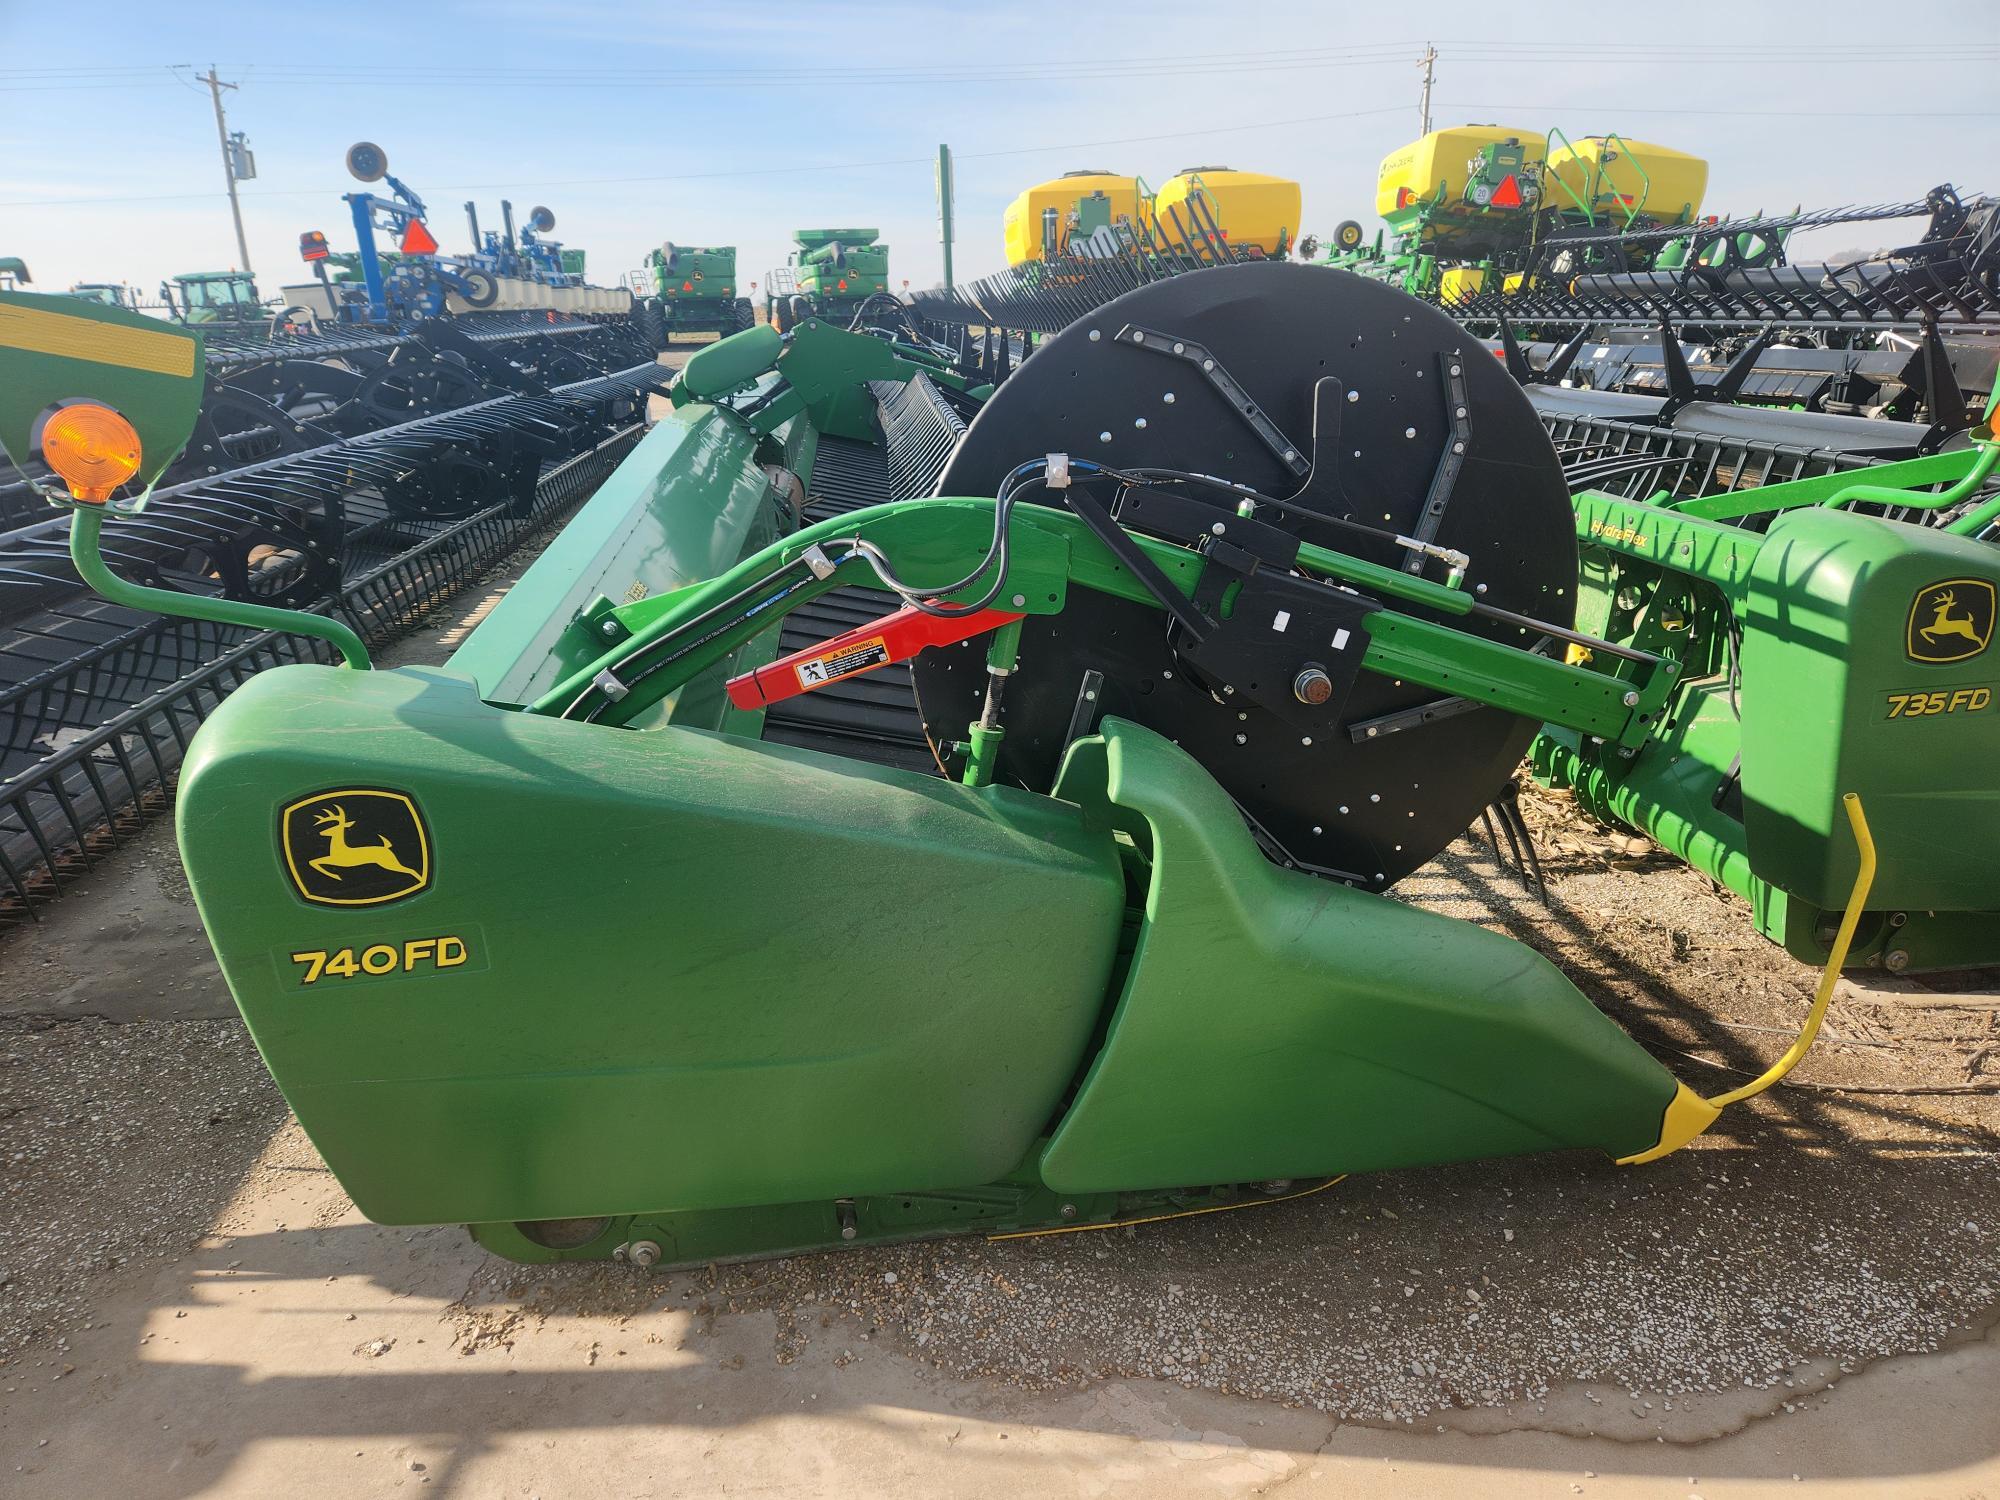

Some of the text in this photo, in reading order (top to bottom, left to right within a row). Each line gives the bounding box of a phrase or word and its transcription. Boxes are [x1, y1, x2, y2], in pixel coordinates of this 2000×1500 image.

[1591, 519, 1648, 547] HydraFlex
[840, 640, 874, 656] WARNING
[1886, 688, 1992, 719] 735FD
[293, 936, 467, 985] 740FD
